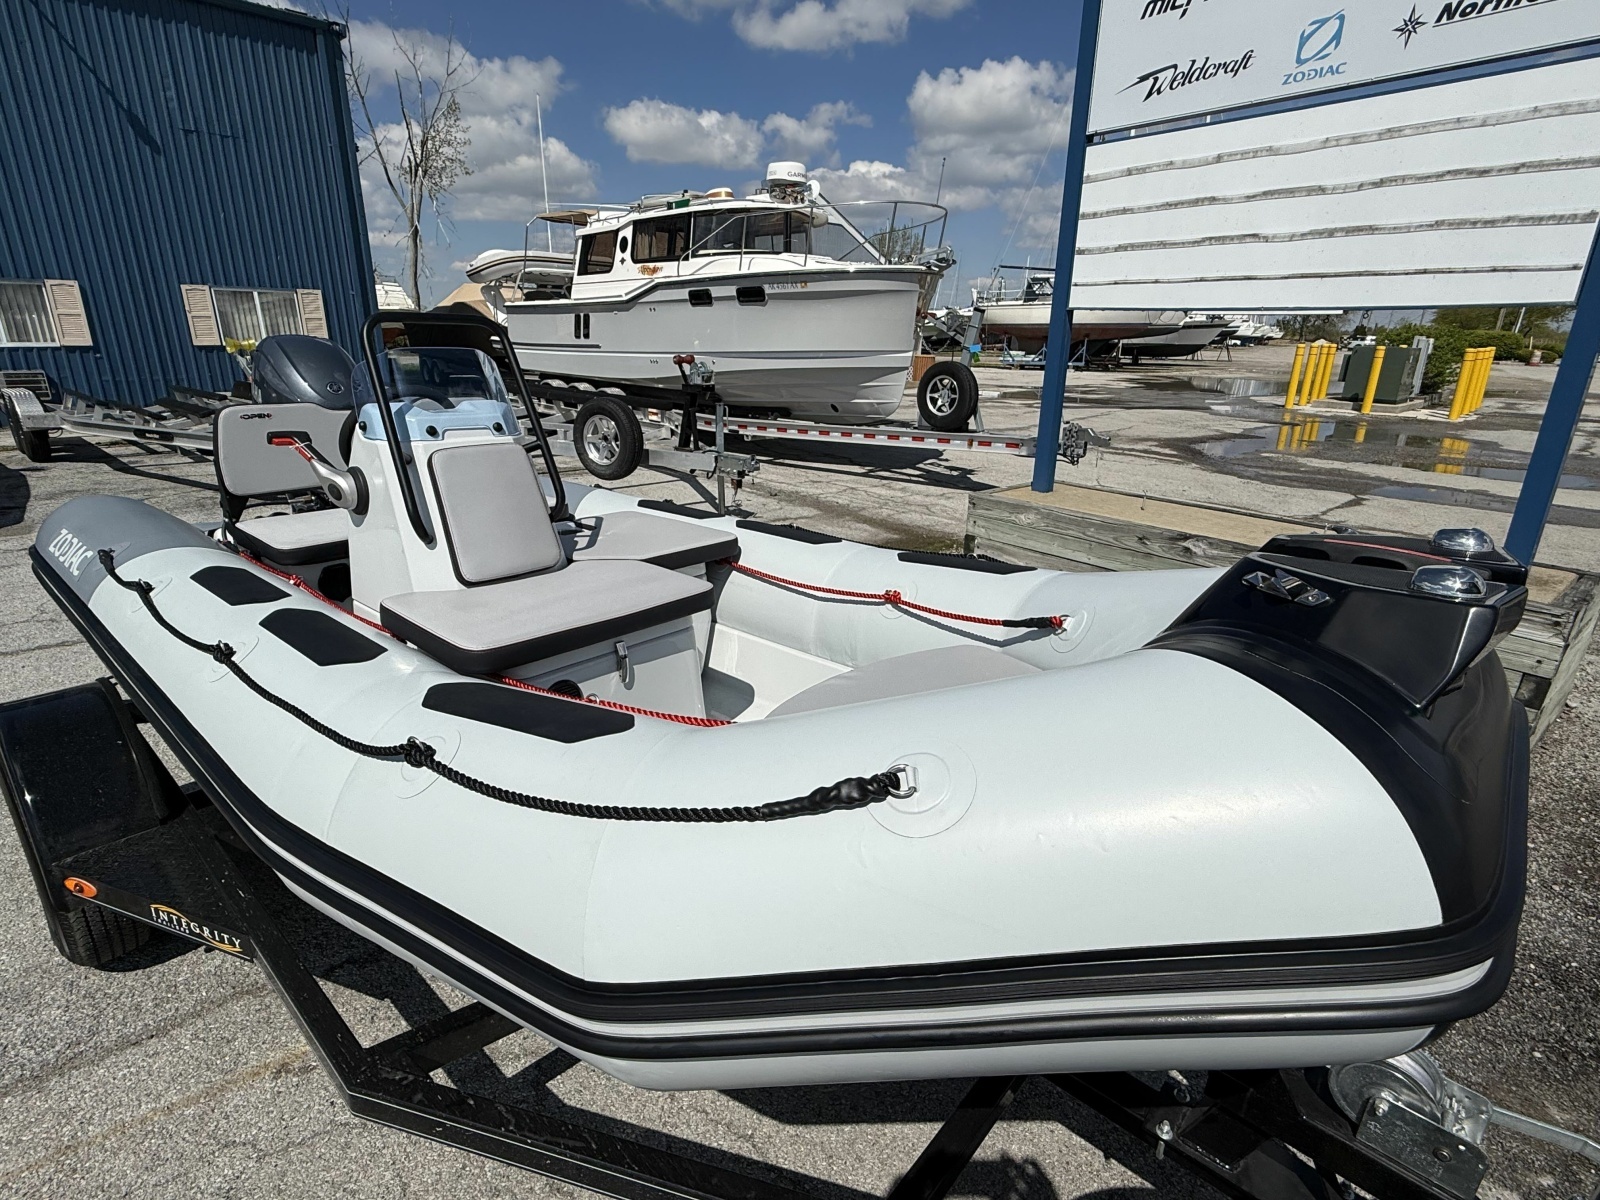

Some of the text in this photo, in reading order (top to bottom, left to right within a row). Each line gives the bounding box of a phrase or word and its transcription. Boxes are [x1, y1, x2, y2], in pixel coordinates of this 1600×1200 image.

[1115, 49, 1256, 102] Weldcraft
[1281, 62, 1347, 85] ZODIAC
[242, 412, 271, 420] OPEN
[48, 528, 94, 576] ZODIAC
[150, 907, 241, 949] INTEGRITY
